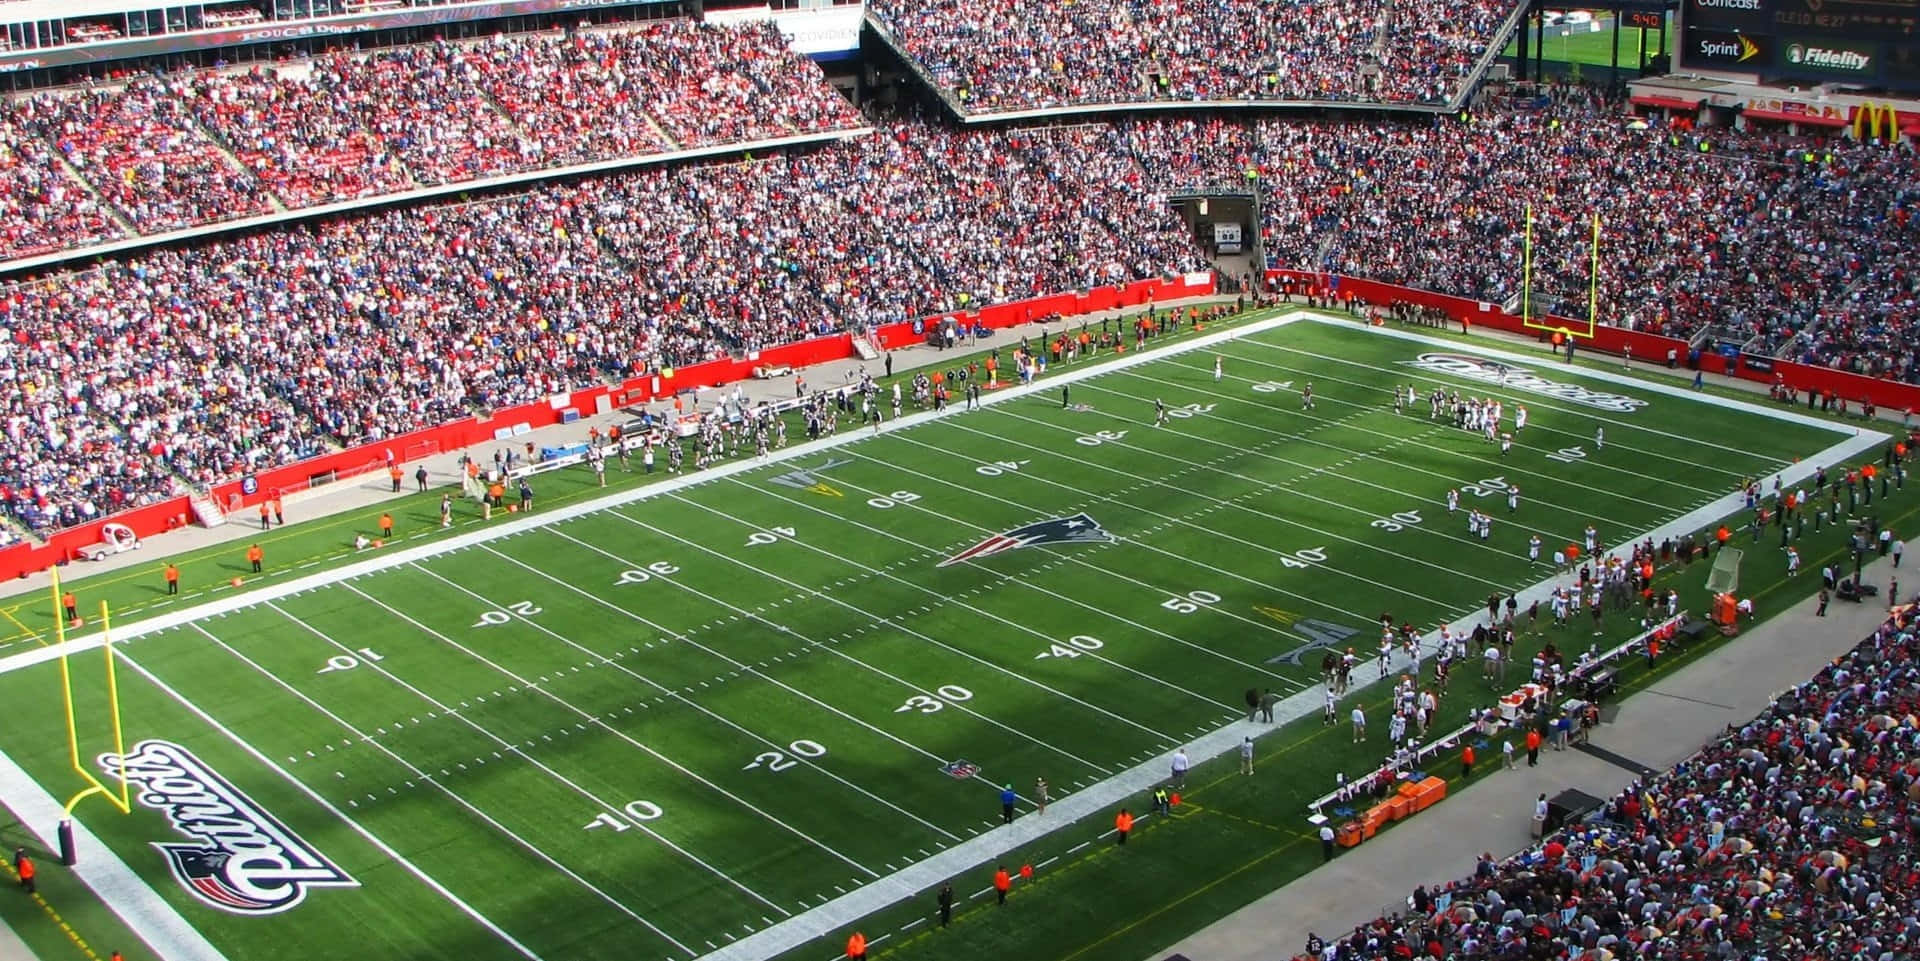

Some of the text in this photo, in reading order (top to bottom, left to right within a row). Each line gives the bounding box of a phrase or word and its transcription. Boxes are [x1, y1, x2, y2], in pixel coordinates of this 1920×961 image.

[1700, 40, 1739, 57] Sprint
[1804, 47, 1870, 69] Fidelity
[1075, 430, 1123, 446] 30
[1545, 447, 1587, 463] 10
[975, 460, 1020, 476] 40
[1461, 478, 1509, 497] 20
[867, 490, 921, 509] 50
[1371, 511, 1423, 533] 30
[749, 526, 796, 544] 40
[1279, 549, 1328, 569] 40
[620, 561, 680, 583] 30
[480, 600, 543, 625] 20
[1160, 590, 1222, 614] 50
[1050, 635, 1104, 658] 40
[327, 647, 384, 670] 10
[905, 684, 974, 714] 30
[755, 739, 828, 773] 20
[97, 740, 361, 908] Patriots
[595, 799, 664, 833] 10
